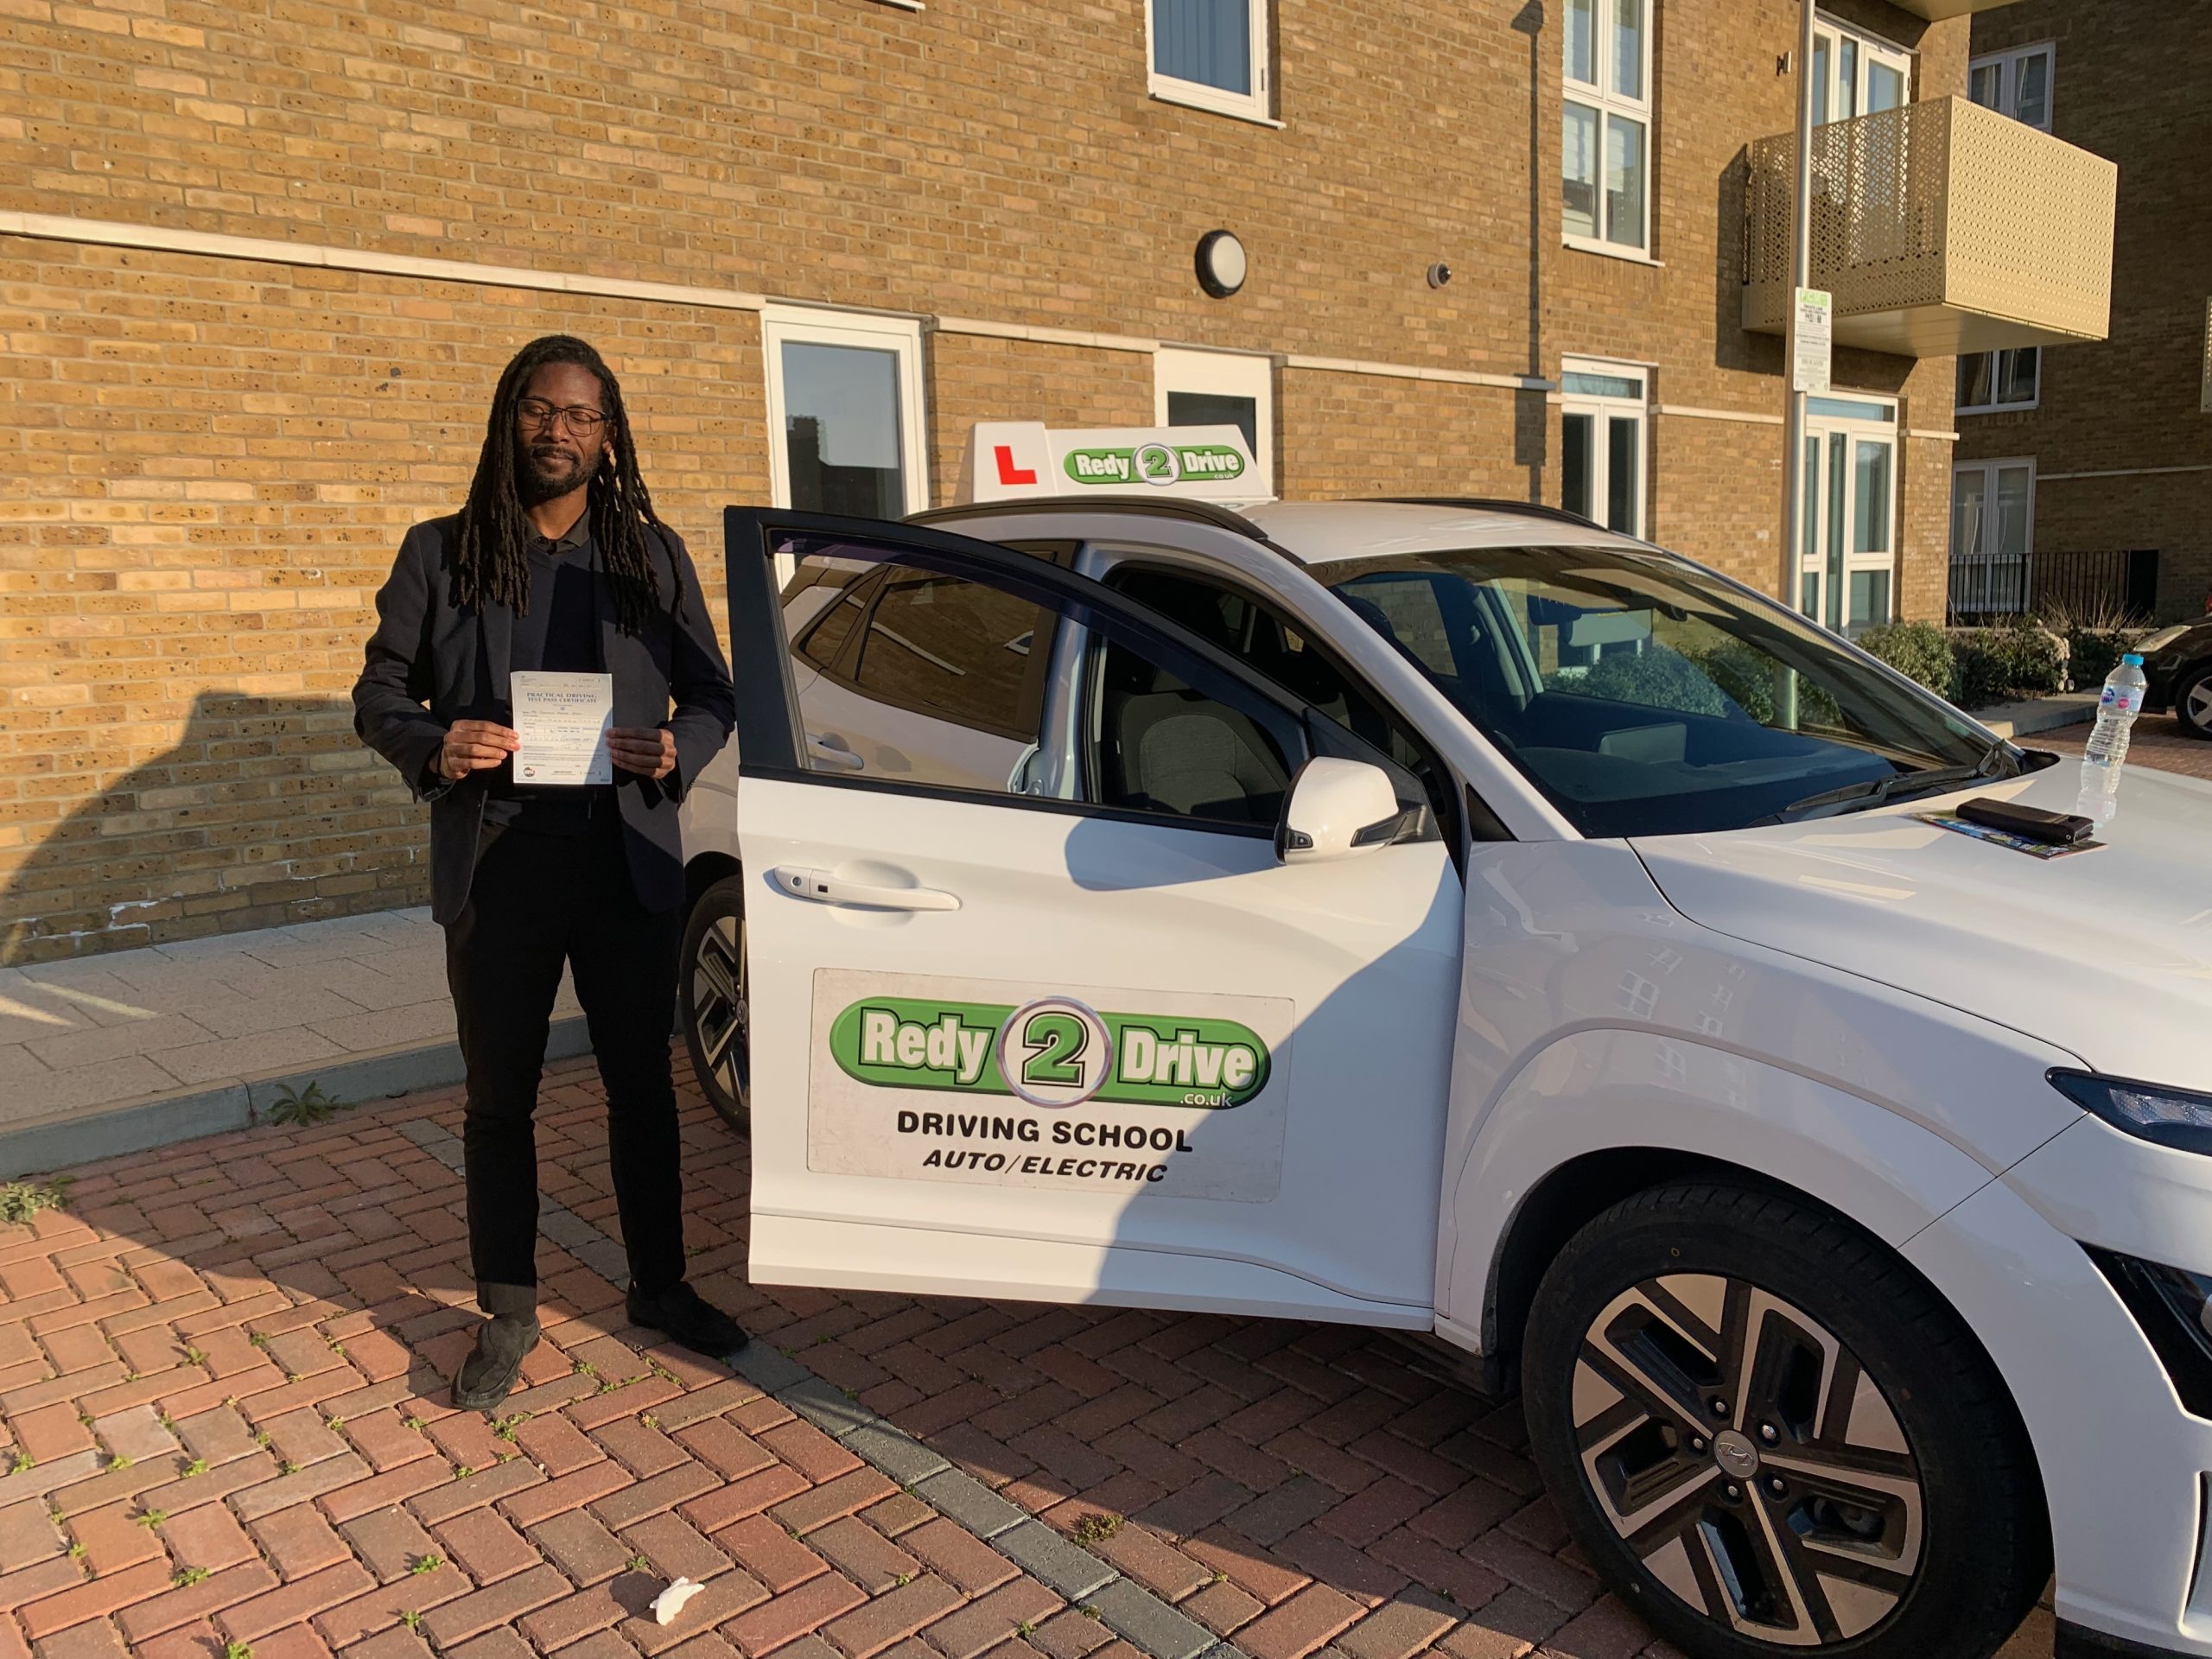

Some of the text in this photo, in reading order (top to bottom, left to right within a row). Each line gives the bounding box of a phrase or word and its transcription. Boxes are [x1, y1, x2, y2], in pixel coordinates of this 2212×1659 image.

[994, 446, 1038, 485] L
[1074, 448, 1242, 480] Redy 2 Drive
[861, 1008, 1256, 1089] Redy 2 Drive
[1179, 1092, 1233, 1108] .co.uk
[897, 1110, 1193, 1153] DRIVING SCHOOL
[922, 1149, 1168, 1183] AUTO/ELECTRIC
